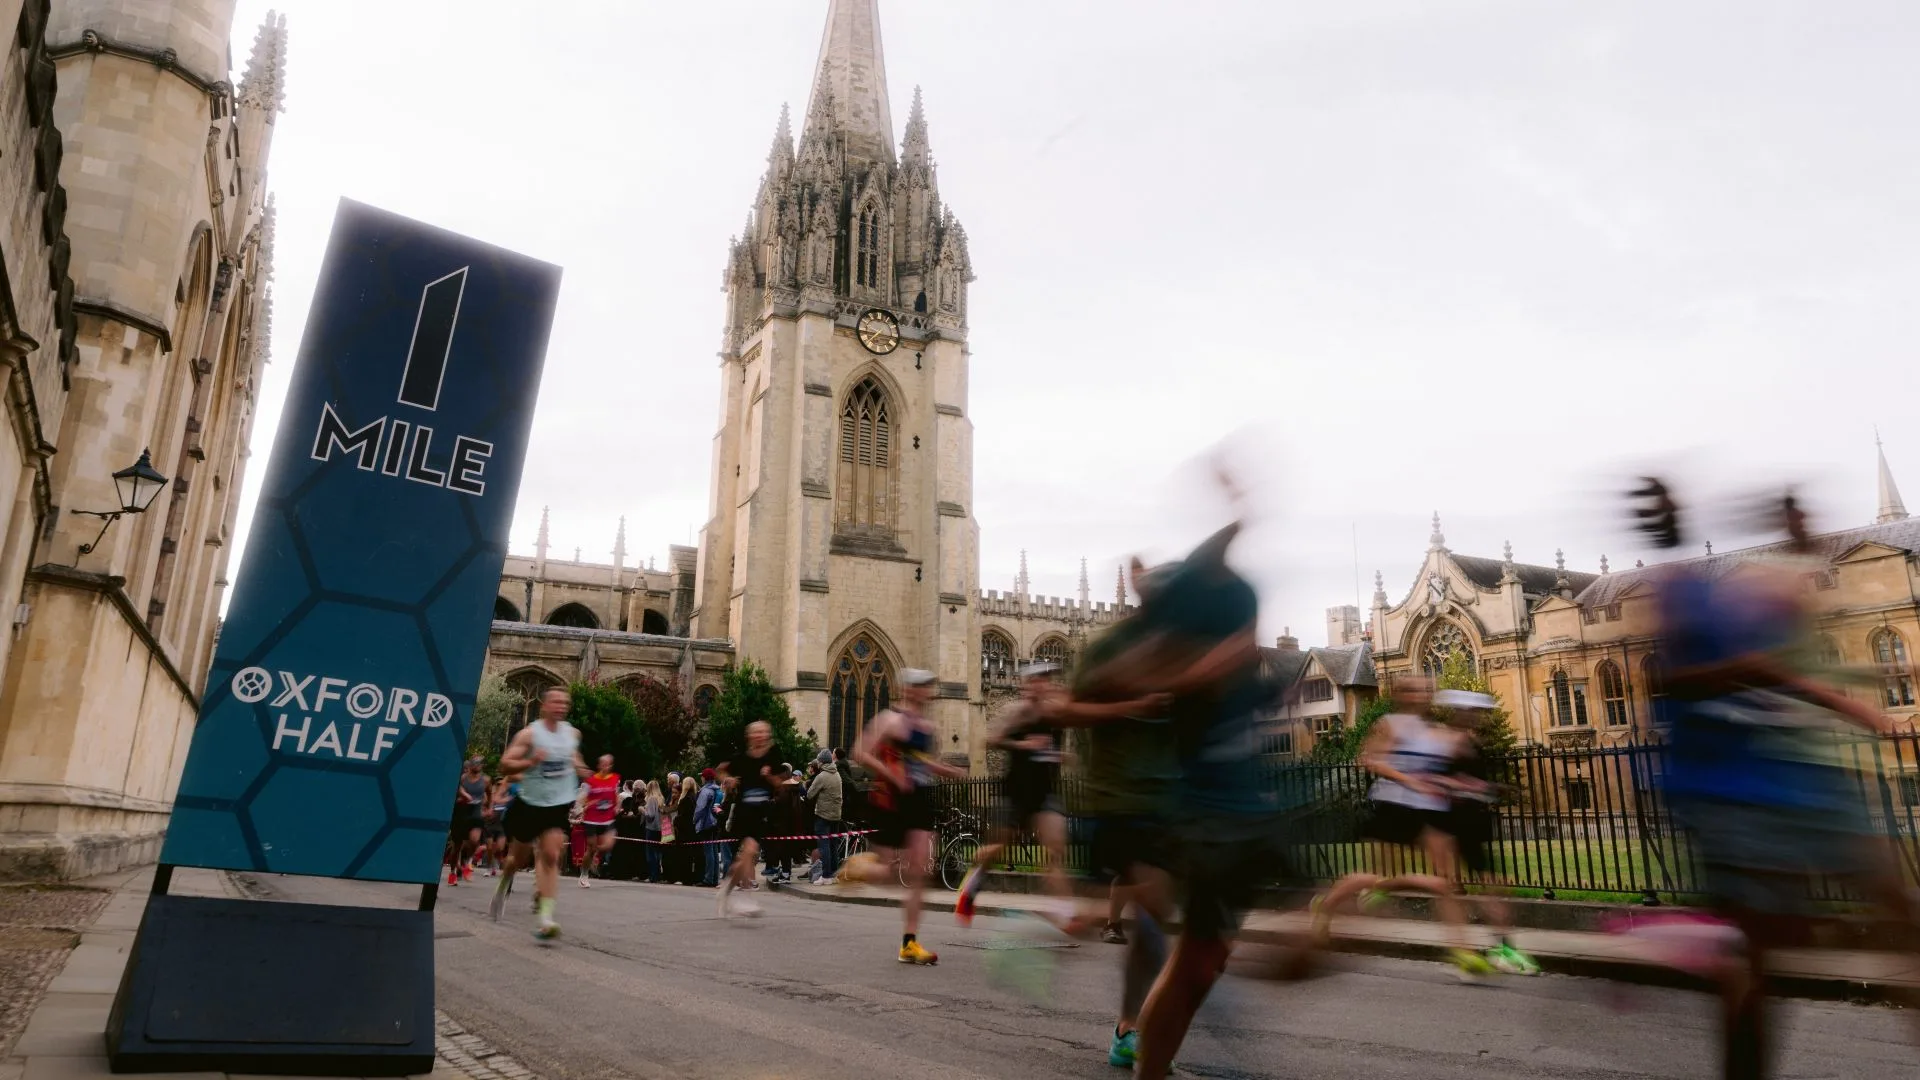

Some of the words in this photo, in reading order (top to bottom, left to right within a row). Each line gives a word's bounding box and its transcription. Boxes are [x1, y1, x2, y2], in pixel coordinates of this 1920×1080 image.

[397, 265, 469, 411] 1
[311, 401, 494, 496] MILE
[231, 666, 454, 728] OXFORD
[272, 713, 400, 761] HALF
